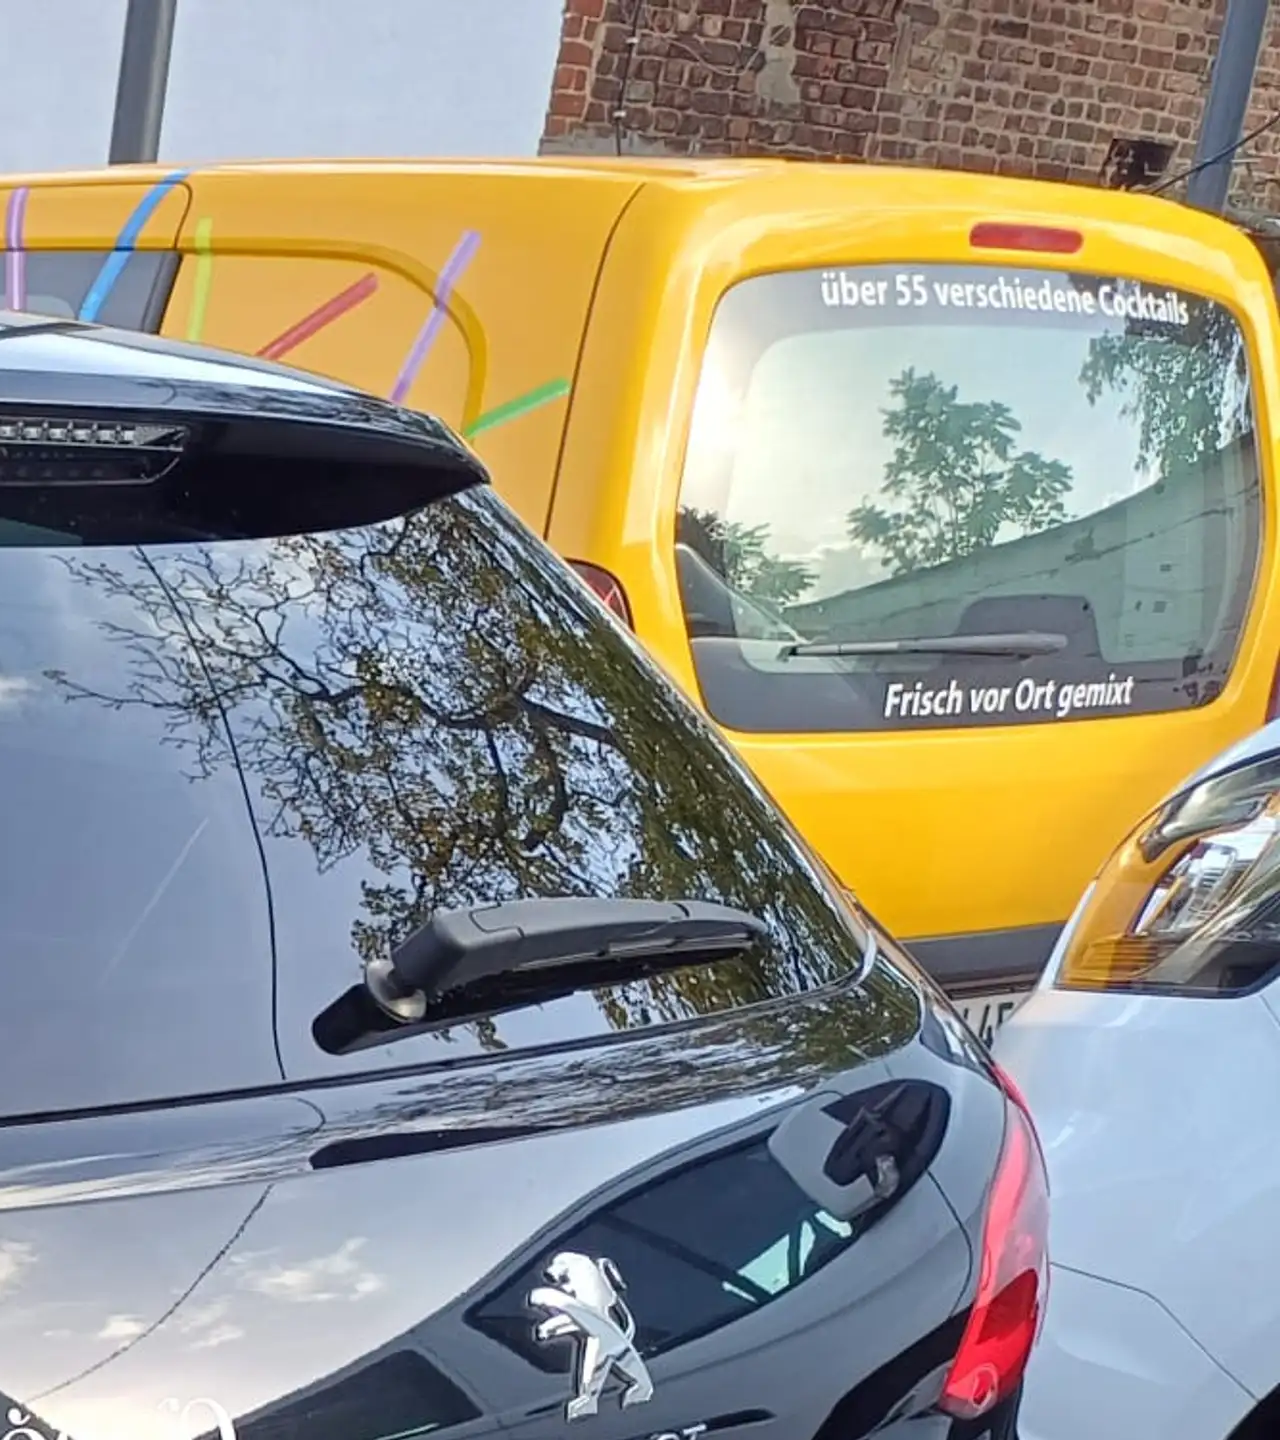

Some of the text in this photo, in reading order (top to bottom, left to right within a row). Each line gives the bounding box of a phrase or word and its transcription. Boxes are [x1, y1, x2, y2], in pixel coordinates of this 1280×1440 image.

[820, 271, 1190, 326] über 55 verschiedene Cocktails
[883, 672, 1135, 718] Frisch vor Ort gemixt
